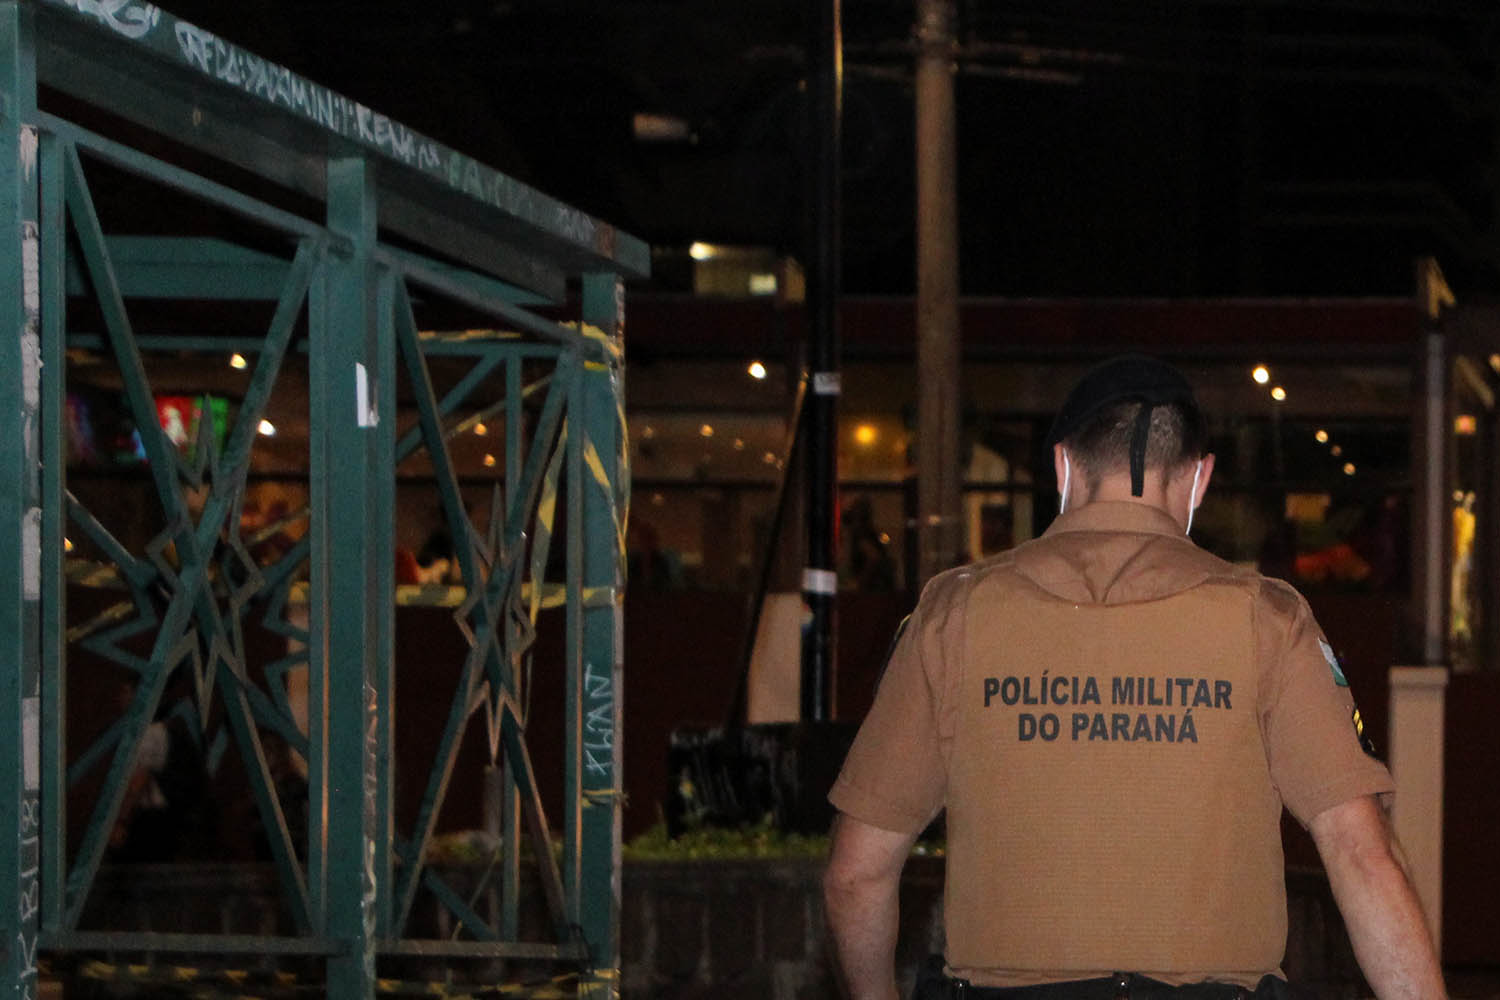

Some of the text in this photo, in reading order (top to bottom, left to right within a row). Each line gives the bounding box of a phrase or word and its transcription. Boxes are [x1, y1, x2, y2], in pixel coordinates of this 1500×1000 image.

[983, 669, 1233, 710] POLÍCIA MILITAR
[1018, 708, 1199, 744] DO PARANÁ
